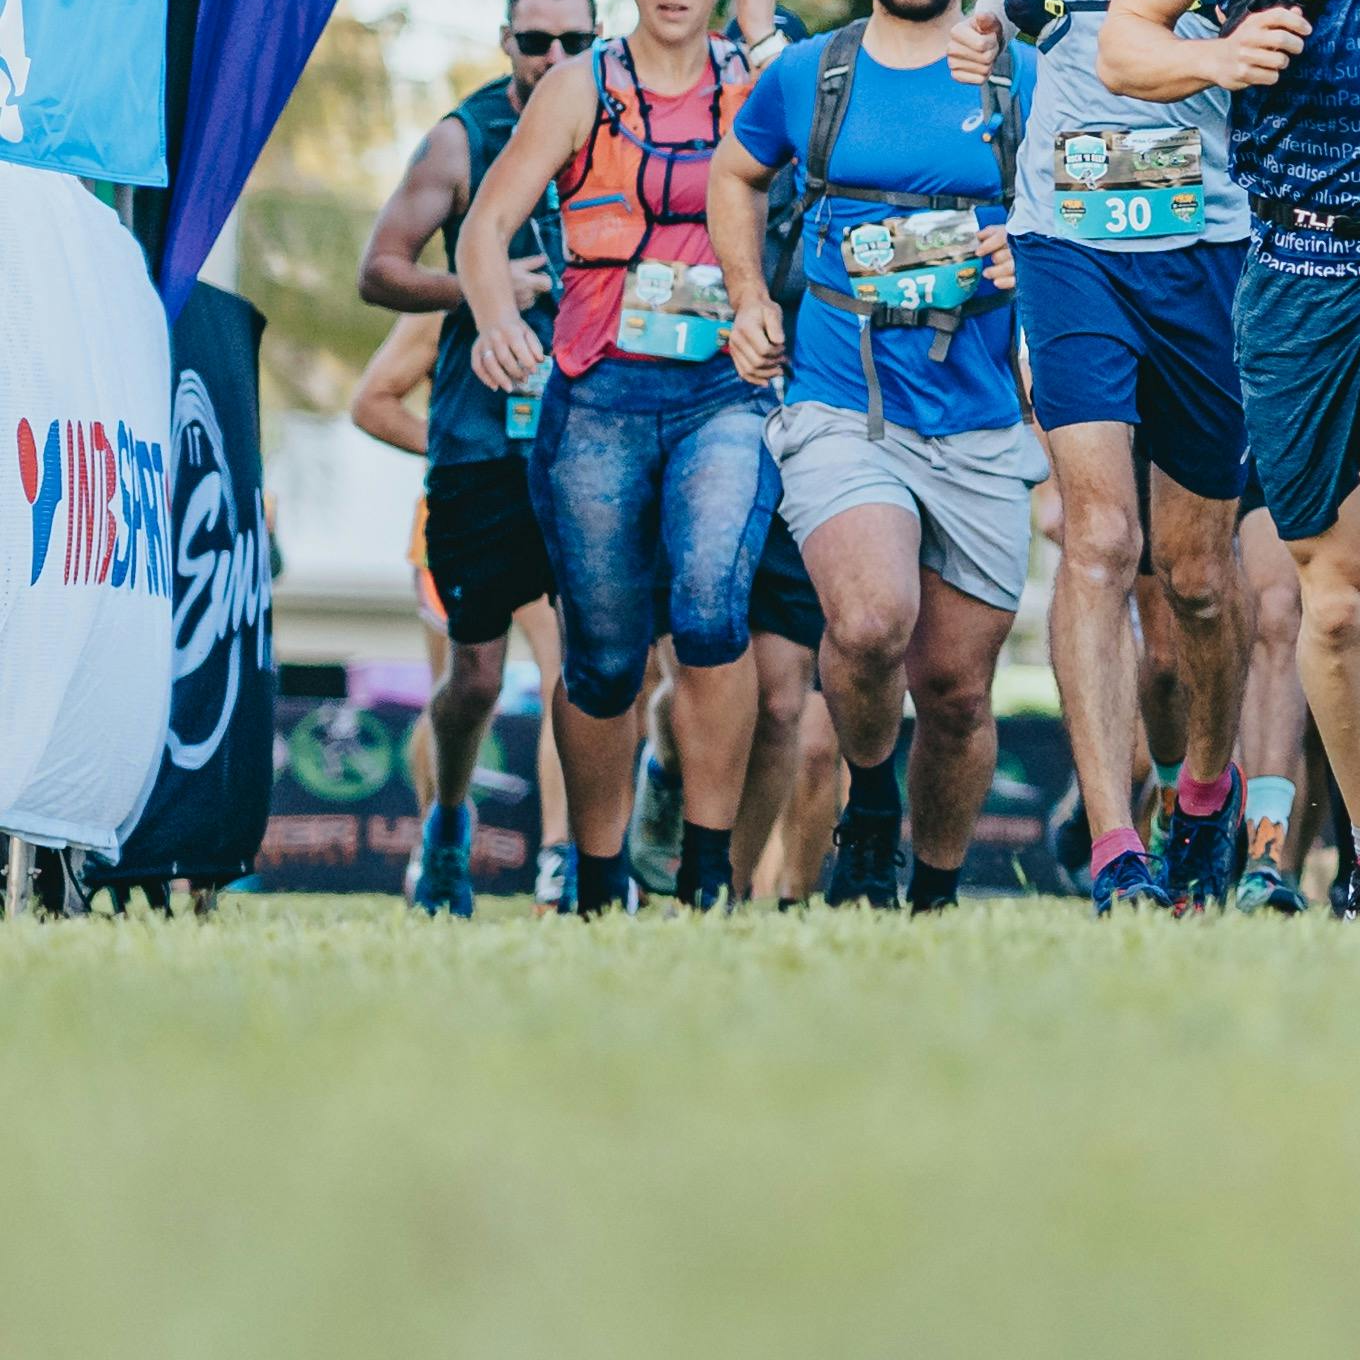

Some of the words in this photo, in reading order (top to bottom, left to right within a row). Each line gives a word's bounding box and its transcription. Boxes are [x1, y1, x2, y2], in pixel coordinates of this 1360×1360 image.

[1105, 196, 1152, 233] 30
[896, 274, 936, 310] 37
[675, 321, 689, 354] 1
